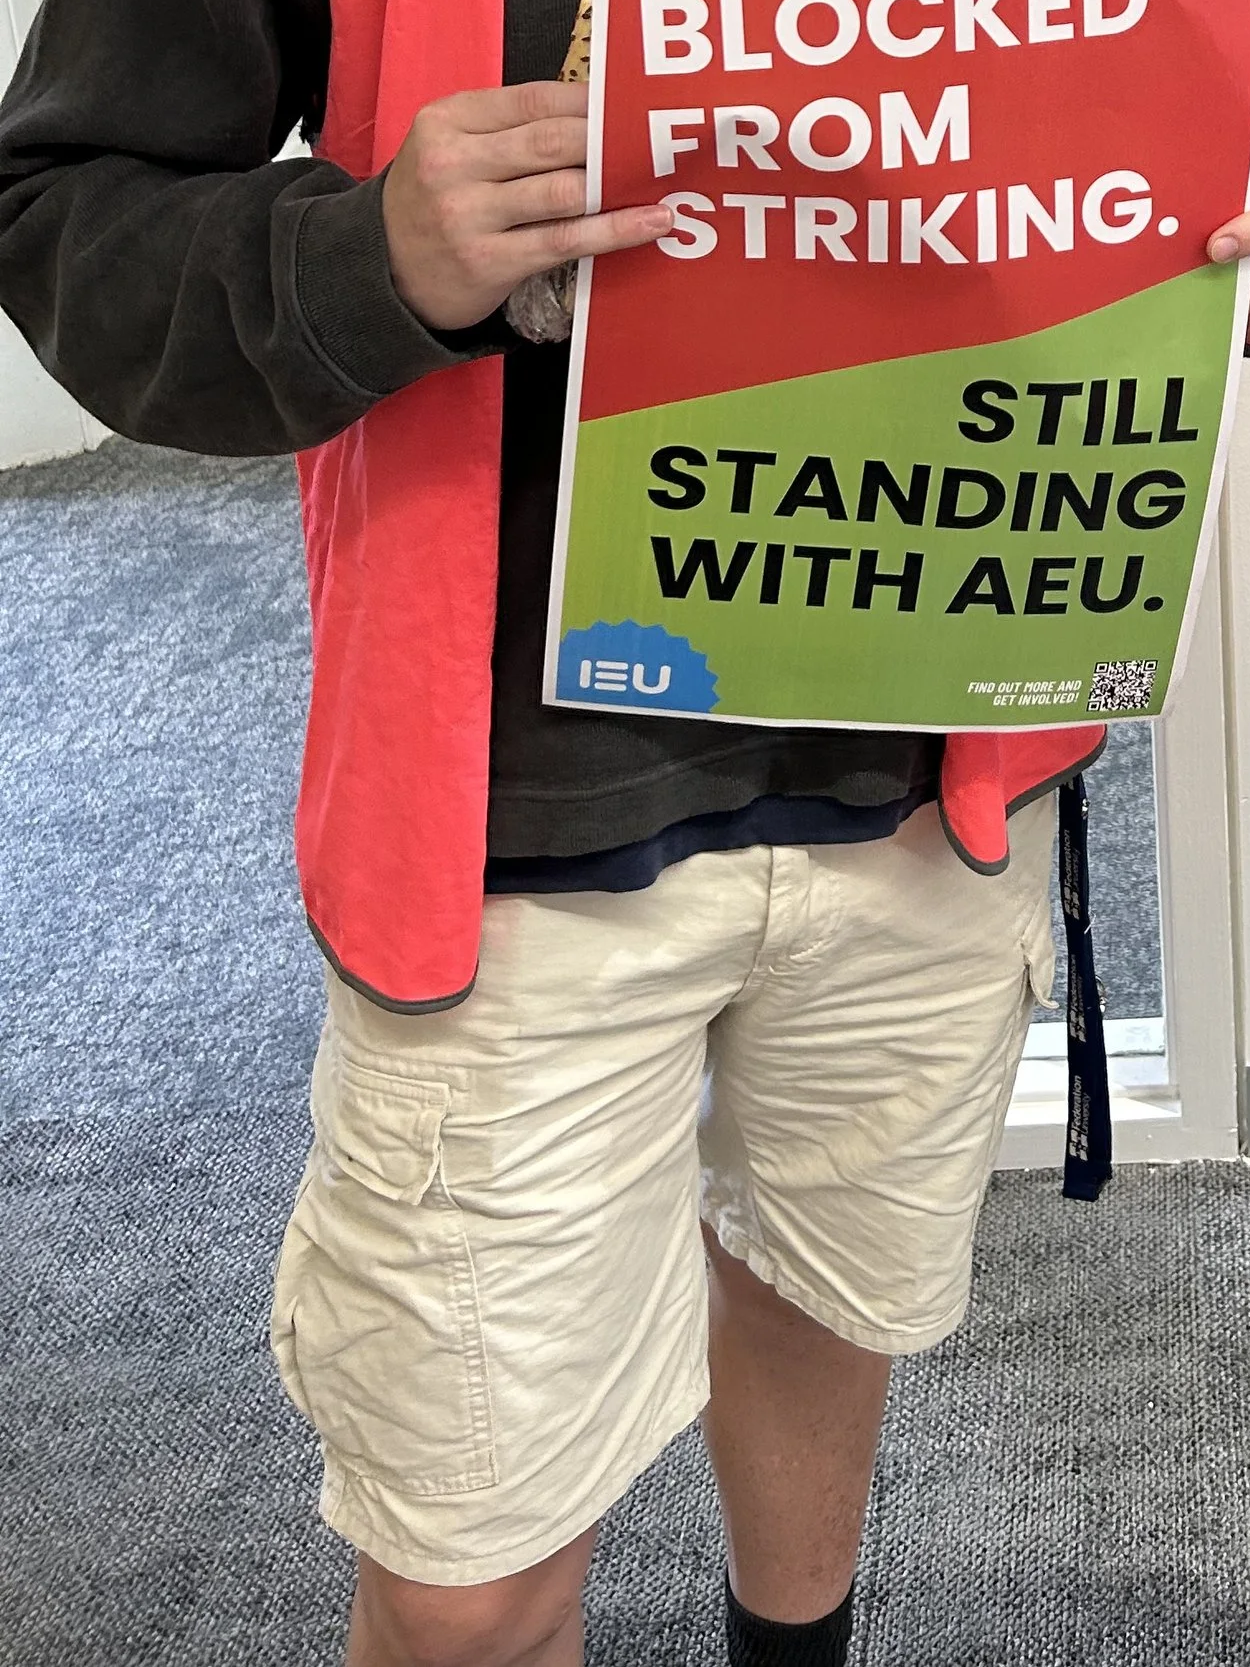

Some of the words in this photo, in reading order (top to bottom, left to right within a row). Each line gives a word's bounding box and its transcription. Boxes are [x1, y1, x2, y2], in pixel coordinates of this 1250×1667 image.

[647, 84, 971, 178] FROM
[659, 170, 1180, 264] STRIKING.
[957, 377, 1199, 446] STILL
[647, 445, 1187, 532] STANDING
[650, 536, 923, 613] WITH
[944, 555, 1164, 615] AEU.
[579, 659, 671, 695] IEU
[968, 682, 994, 694] FIND
[996, 682, 1020, 693] OUT
[1024, 681, 1054, 692] MORE
[1058, 680, 1082, 691] AND
[993, 694, 1014, 706] GET
[1018, 693, 1079, 706] INVOLVED!
[1072, 1074, 1082, 1131] Federation
